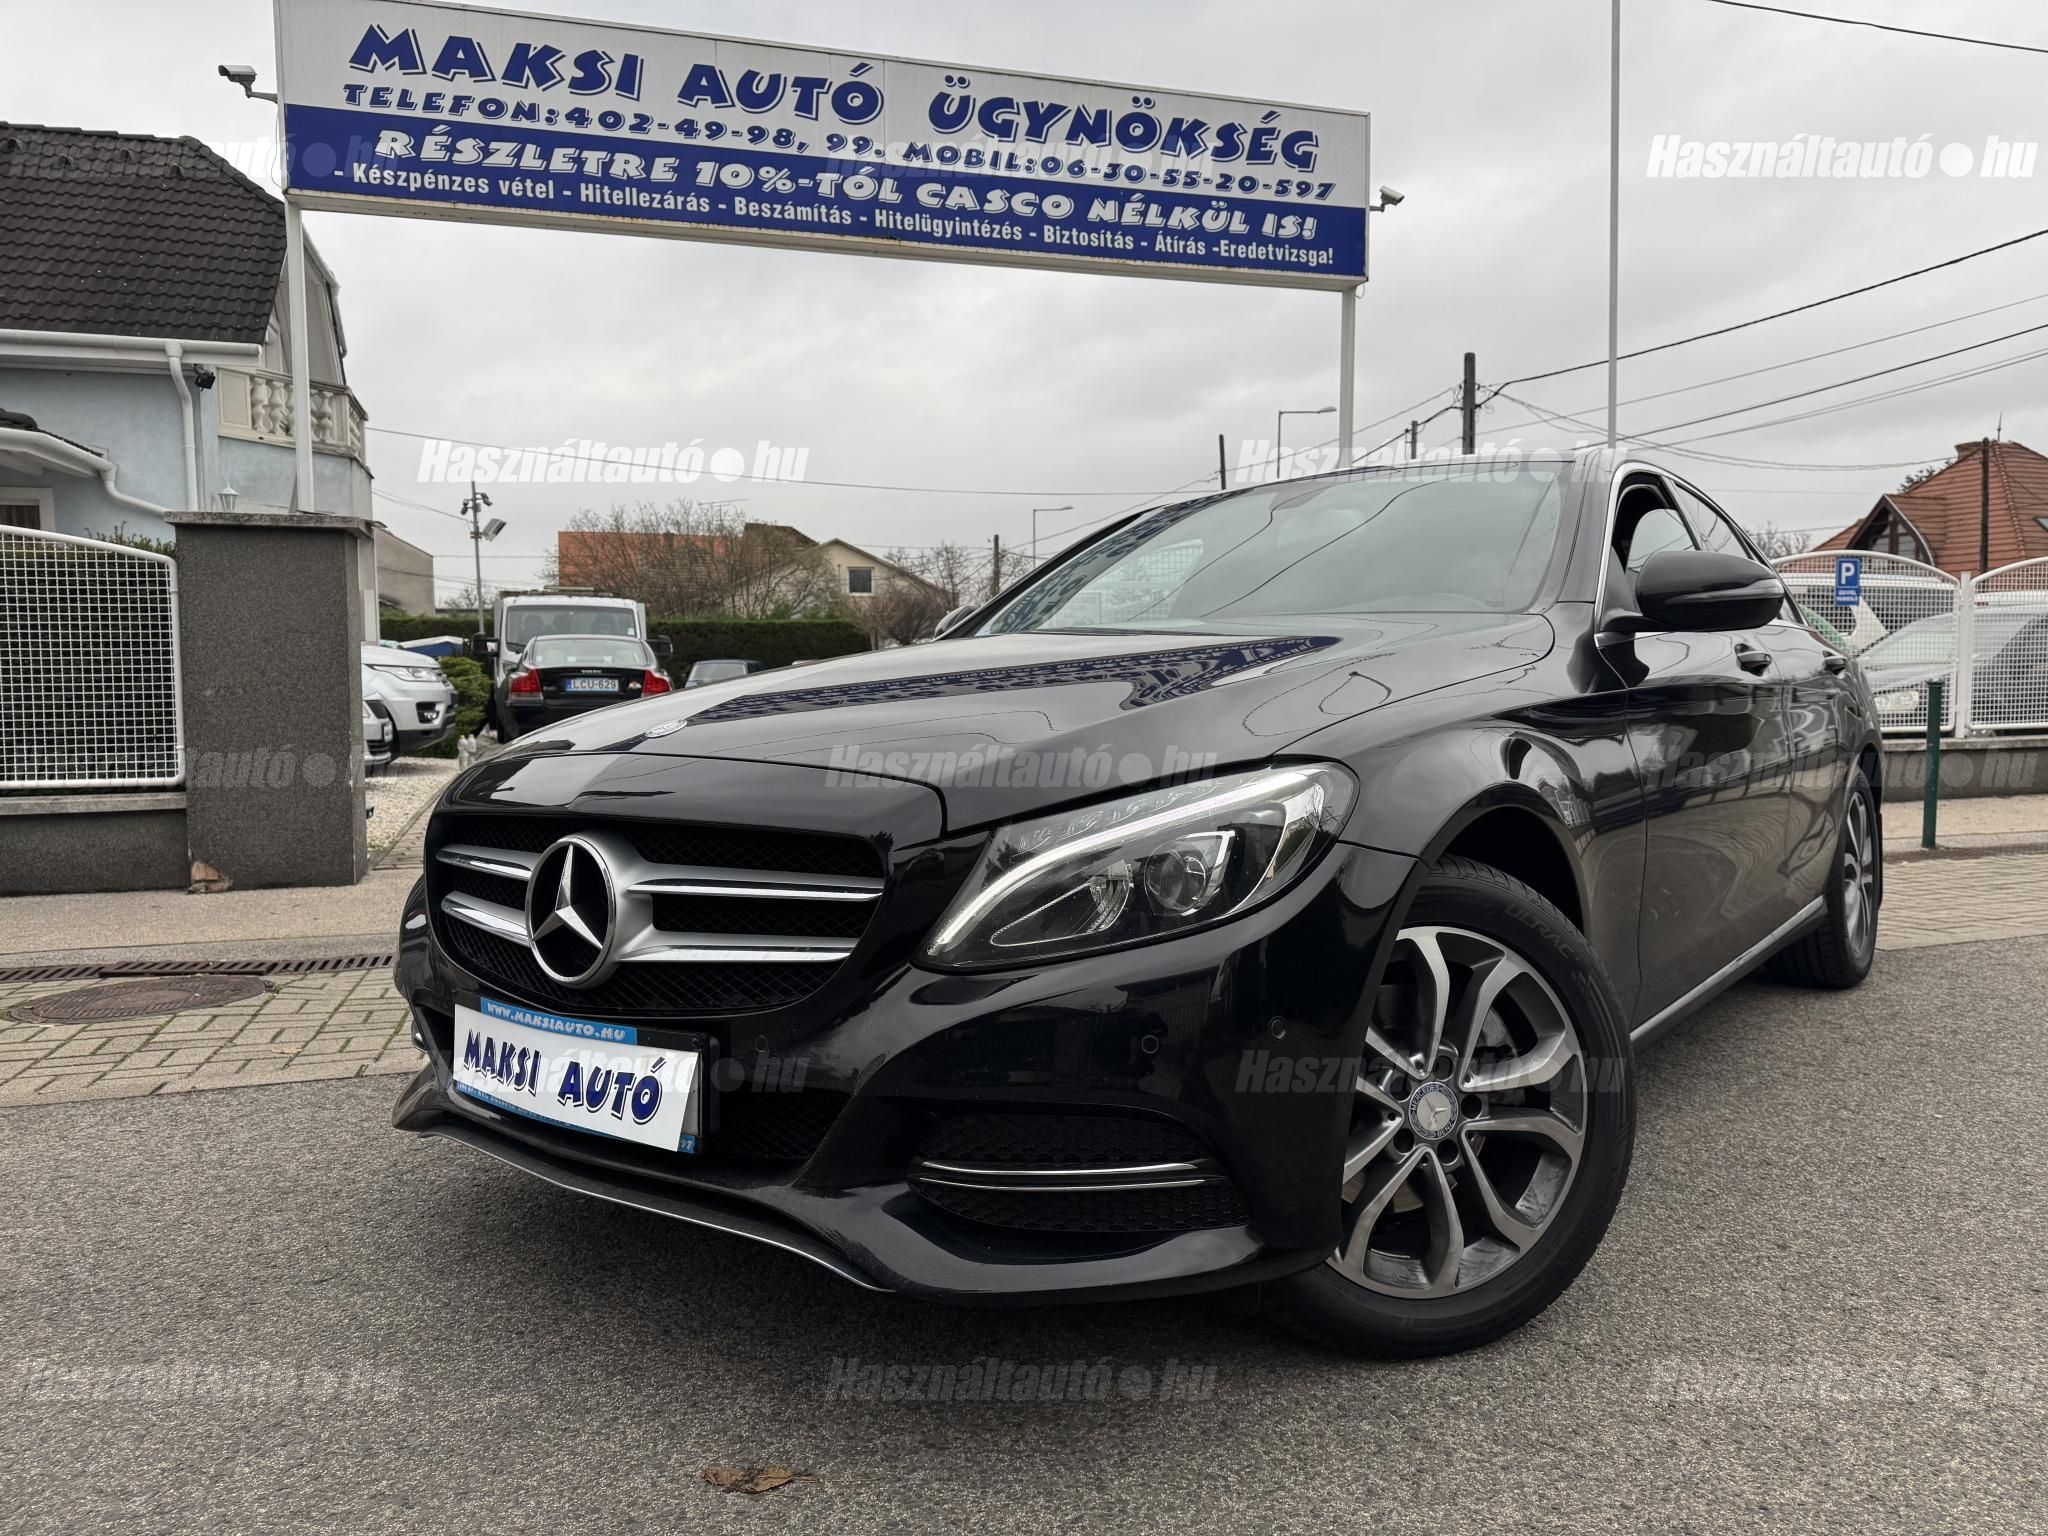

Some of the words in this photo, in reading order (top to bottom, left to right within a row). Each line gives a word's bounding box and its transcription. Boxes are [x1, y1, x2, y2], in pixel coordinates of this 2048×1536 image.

[349, 24, 644, 101] MAKSI
[677, 62, 884, 125] AUTÓ
[928, 74, 1319, 172] ÜGYNÖKSÉG
[353, 163, 490, 194] Készpénzes
[498, 176, 555, 199] vétel
[580, 183, 710, 212] Hitellezárás
[735, 196, 852, 224] Beszámítás
[874, 209, 1023, 240] Hitelügyintézés
[1043, 225, 1134, 249] Biztosítás
[1154, 232, 1206, 255] Átírás
[375, 124, 679, 182] RÉSZLETRE
[696, 161, 902, 203] 10%-TÓL
[916, 182, 1075, 219] CASCO
[1087, 193, 1249, 235] NÉLKÜL
[1262, 213, 1317, 240] IS!
[572, 679, 617, 689] LCU-629
[487, 1002, 626, 1041] WWW.MAKSIAUTO.HU
[463, 1028, 542, 1096] MAKSI
[557, 1057, 666, 1126] AUTÓ
[1410, 1083, 1441, 1111] MERCEDES
[1437, 1120, 1454, 1138] BENZ
